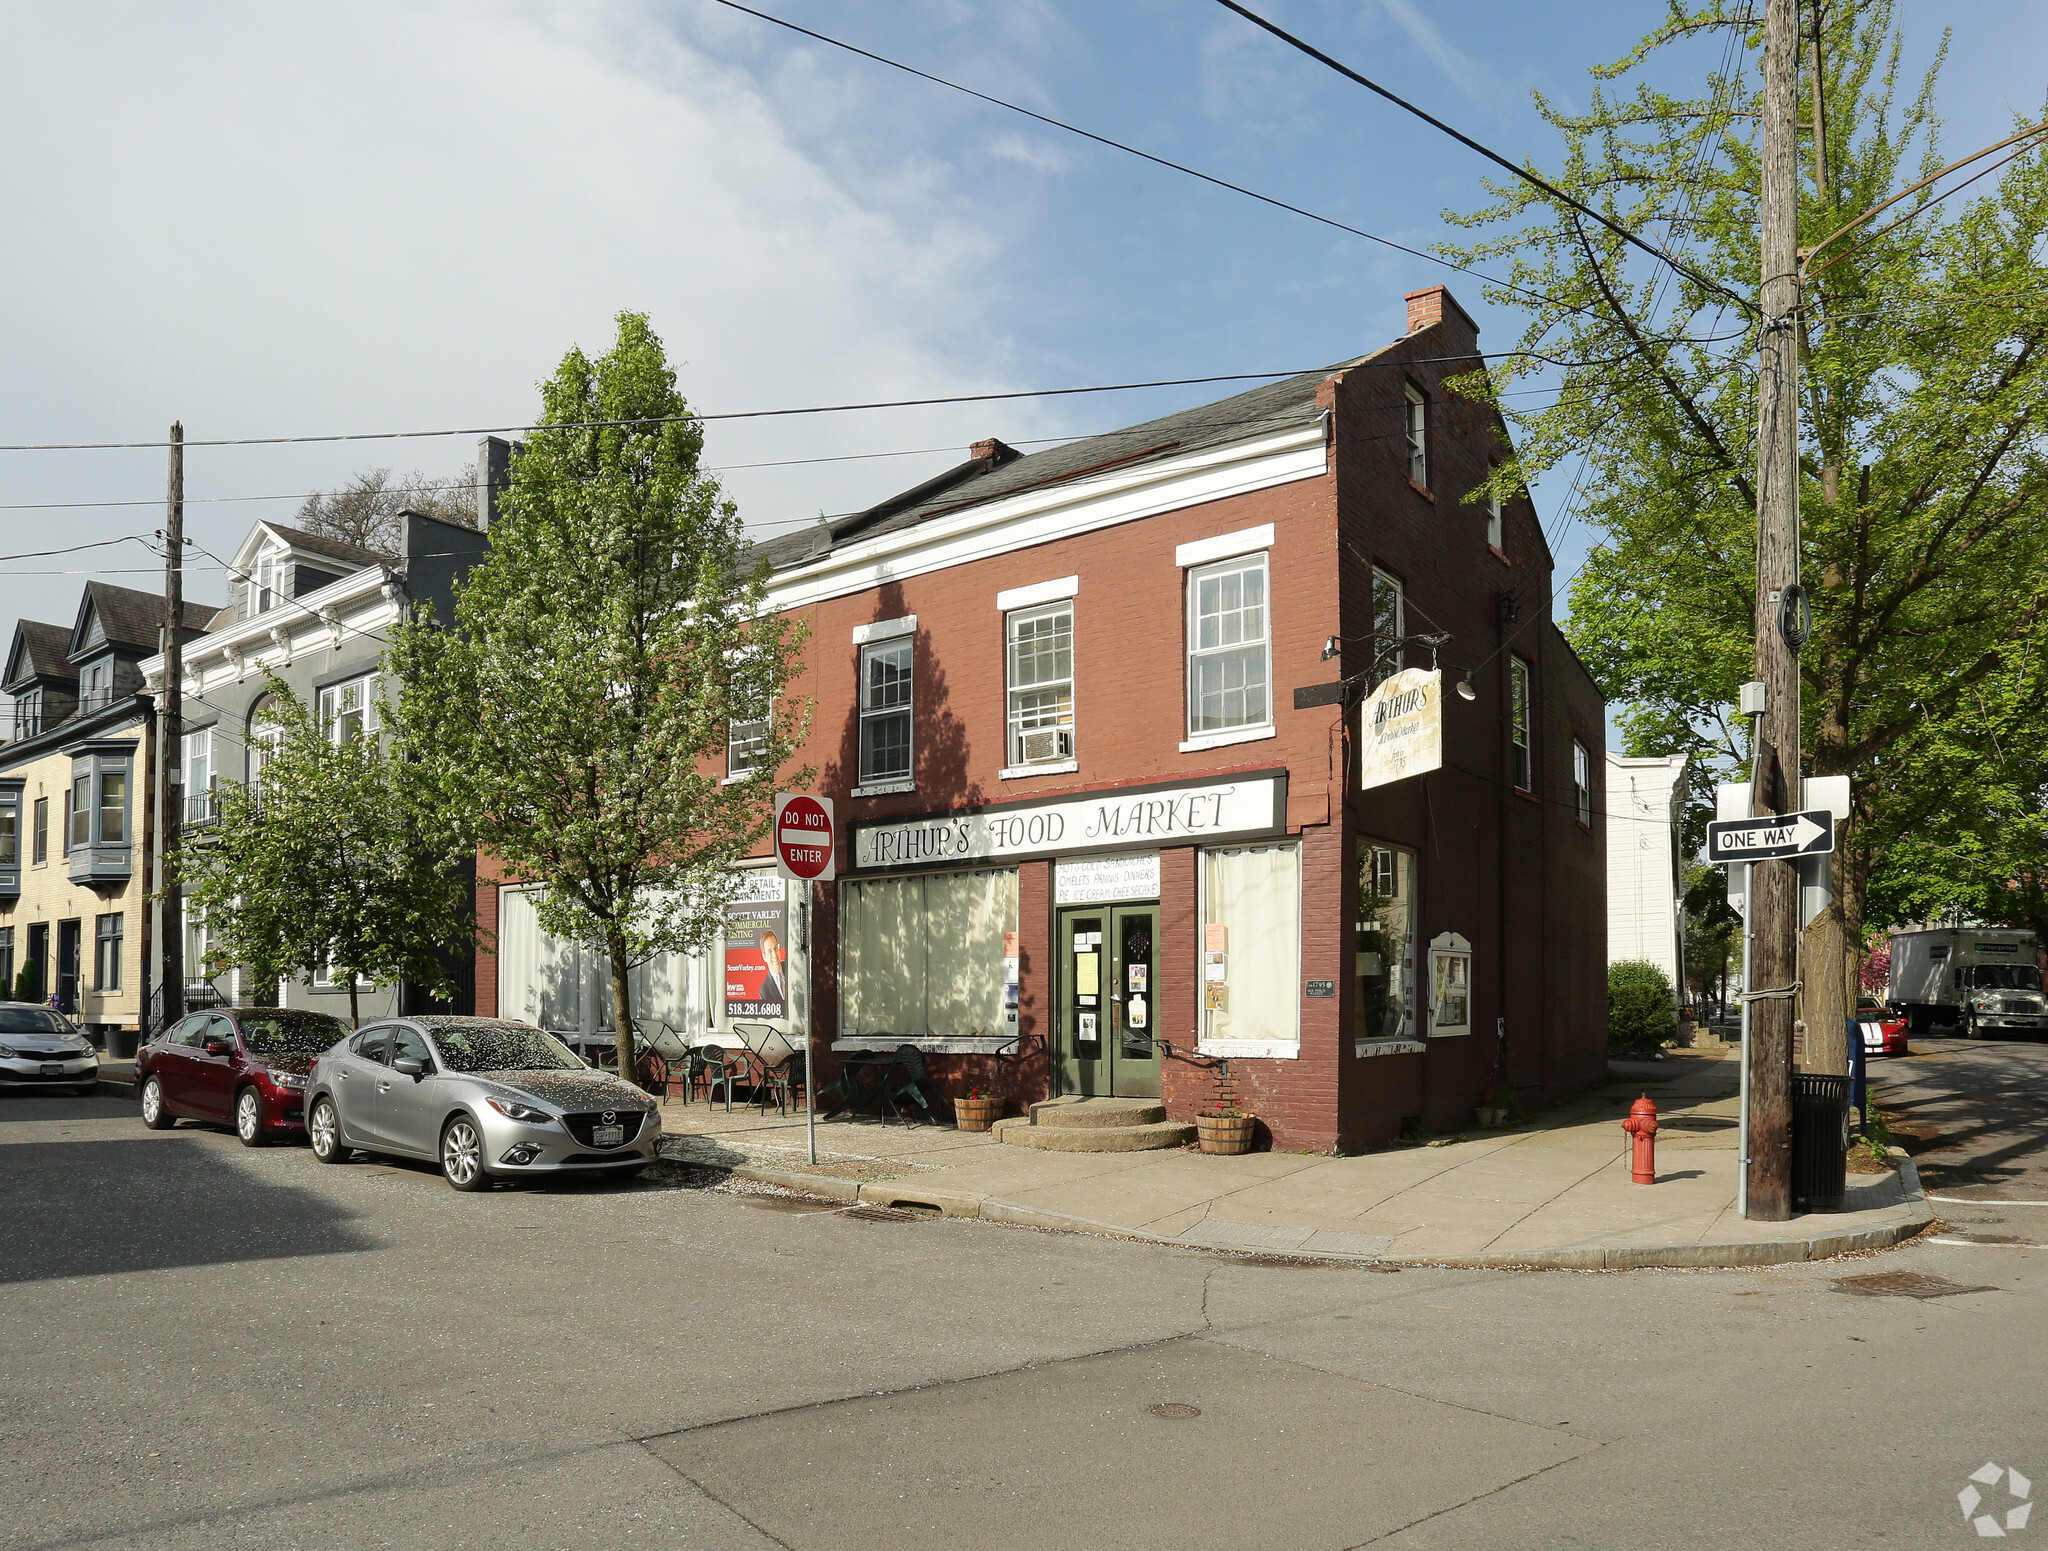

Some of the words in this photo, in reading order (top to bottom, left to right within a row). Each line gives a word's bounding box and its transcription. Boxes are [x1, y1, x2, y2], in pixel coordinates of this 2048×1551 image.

[1369, 685, 1429, 728] ARTHUR'S
[786, 812, 799, 825] DO
[805, 814, 825, 826] NOT
[862, 817, 970, 864] ARTHUR'S
[988, 812, 1065, 848] FOOD
[1085, 786, 1236, 838] MARKET
[1722, 832, 1756, 848] ONE
[1764, 827, 1796, 846] WAY
[790, 848, 822, 863] ENTER
[1082, 860, 1101, 871] COLD
[1103, 854, 1153, 870] SANDWICHES
[1059, 875, 1090, 887] OMELETS
[1124, 868, 1155, 882] DINNERS
[1073, 889, 1085, 900] ICE
[1086, 888, 1110, 900] CREAM
[728, 911, 751, 921] SCOTT
[752, 910, 781, 920] VARLEY
[728, 920, 772, 930] COMMERCIAL
[728, 1003, 782, 1016] 518.281.6808
